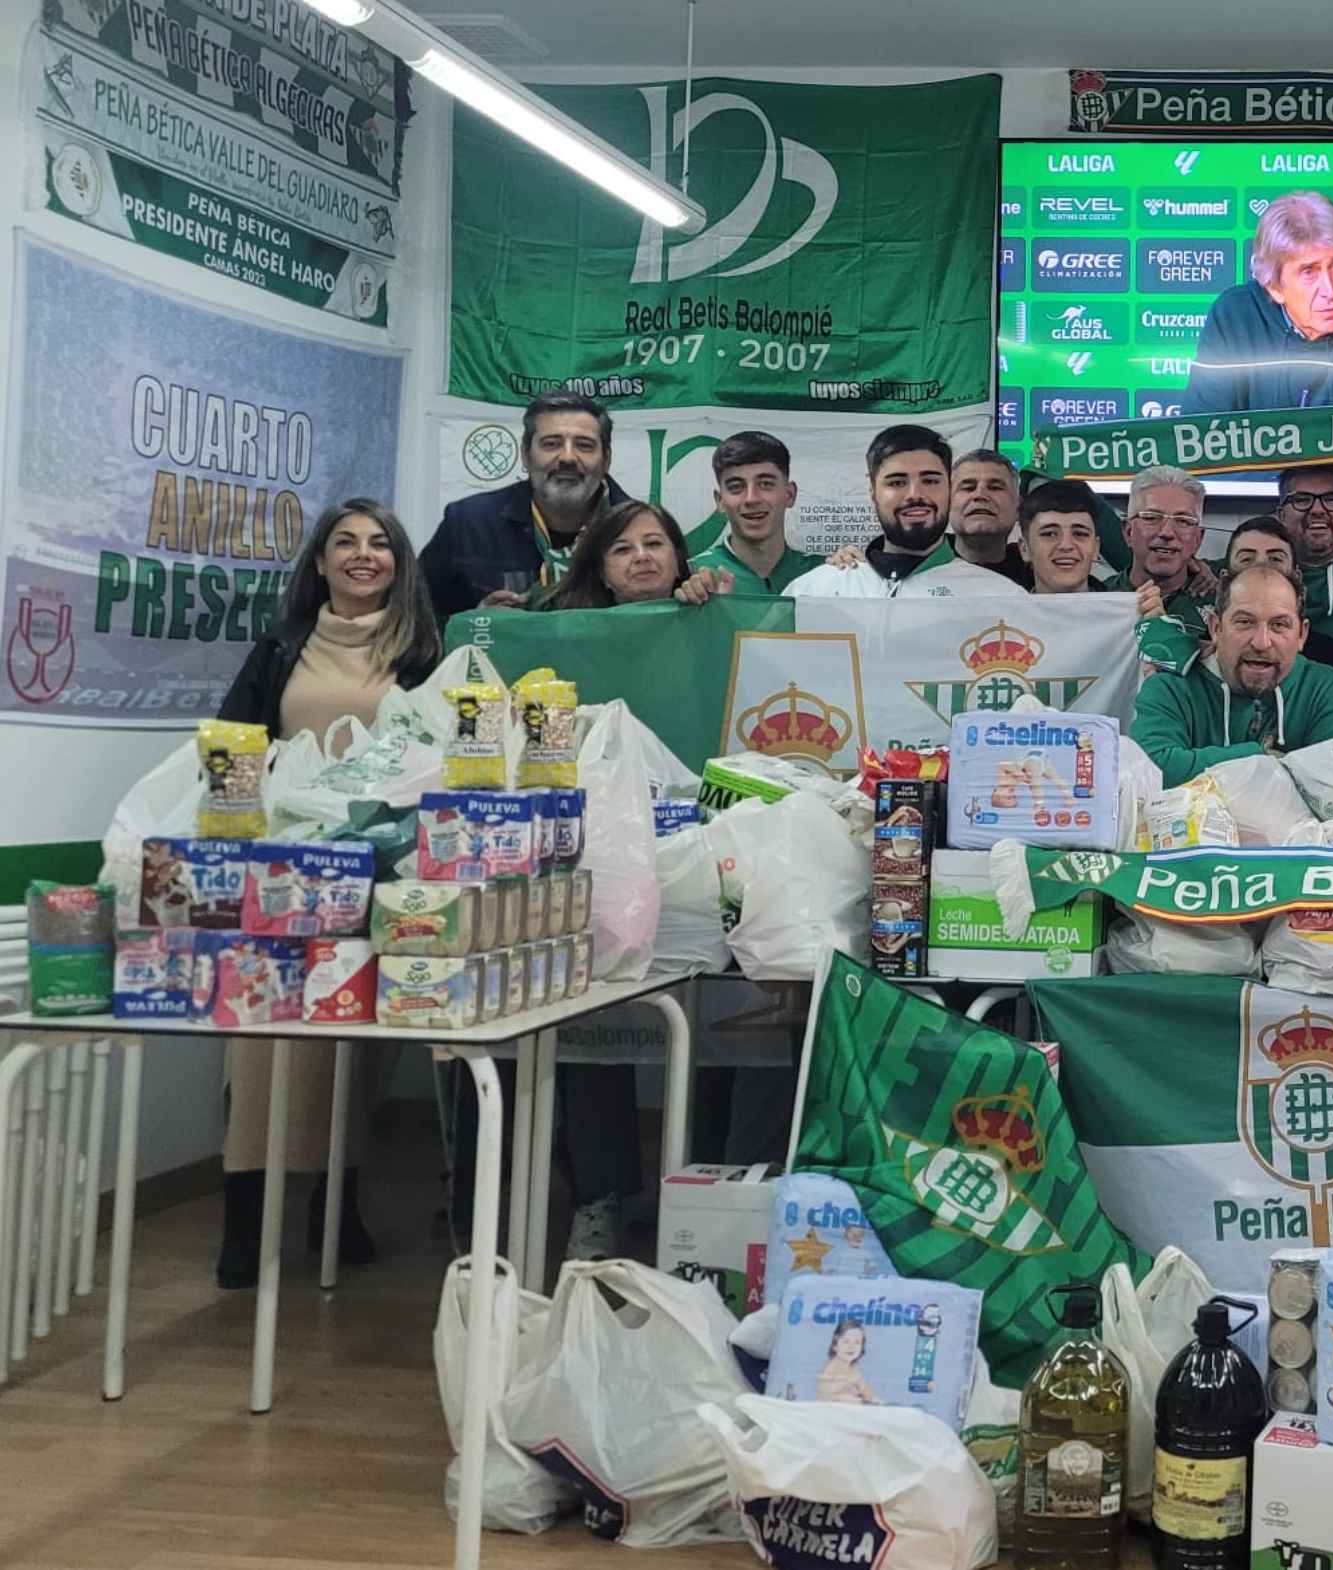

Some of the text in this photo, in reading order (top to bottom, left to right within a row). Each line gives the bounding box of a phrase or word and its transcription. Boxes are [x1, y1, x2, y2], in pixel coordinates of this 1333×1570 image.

[273, 0, 350, 82] PLATA
[130, 2, 347, 147] PEÑA BÉTICA ALGECIRAS
[1136, 87, 1232, 123] Peña
[95, 78, 142, 131] PEÑA
[146, 101, 205, 158] BÉTICA
[208, 129, 255, 179] VALLE
[257, 154, 285, 194] DEL
[286, 168, 360, 226] GUADIARO
[1048, 154, 1115, 173] LALIGA
[1261, 154, 1330, 173] LALIGA
[1039, 197, 1125, 212] REVEL
[1165, 199, 1229, 216] hummel
[188, 191, 291, 250] PEÑA BÉTICA
[121, 193, 336, 293] PRESIDENTE ÁNGEL HARO
[203, 253, 240, 278] CAMAS
[1061, 253, 1124, 269] GREE
[1160, 267, 1213, 283] GREEN
[624, 295, 834, 339] Real Betis Balompié
[1051, 328, 1114, 341] GLOBAL
[622, 333, 832, 373] 1907 2007
[565, 377, 596, 397] 100
[598, 375, 645, 397] años
[809, 378, 860, 399] tuyos
[131, 374, 312, 486] CUARTO
[1062, 430, 1162, 470] Peña
[1174, 411, 1303, 464] Bética
[146, 469, 304, 562] ANILLO
[984, 720, 1079, 747] chelino
[468, 799, 521, 814] PULEVA
[187, 842, 241, 855] PULEVA
[303, 853, 361, 868] PULEVA
[191, 865, 242, 889] Tido
[1137, 865, 1277, 911] Peña
[939, 908, 972, 921] Leche
[937, 922, 1081, 945] SEMIDESATADA
[1213, 1197, 1309, 1241] Peña
[812, 1296, 920, 1327] chelino
